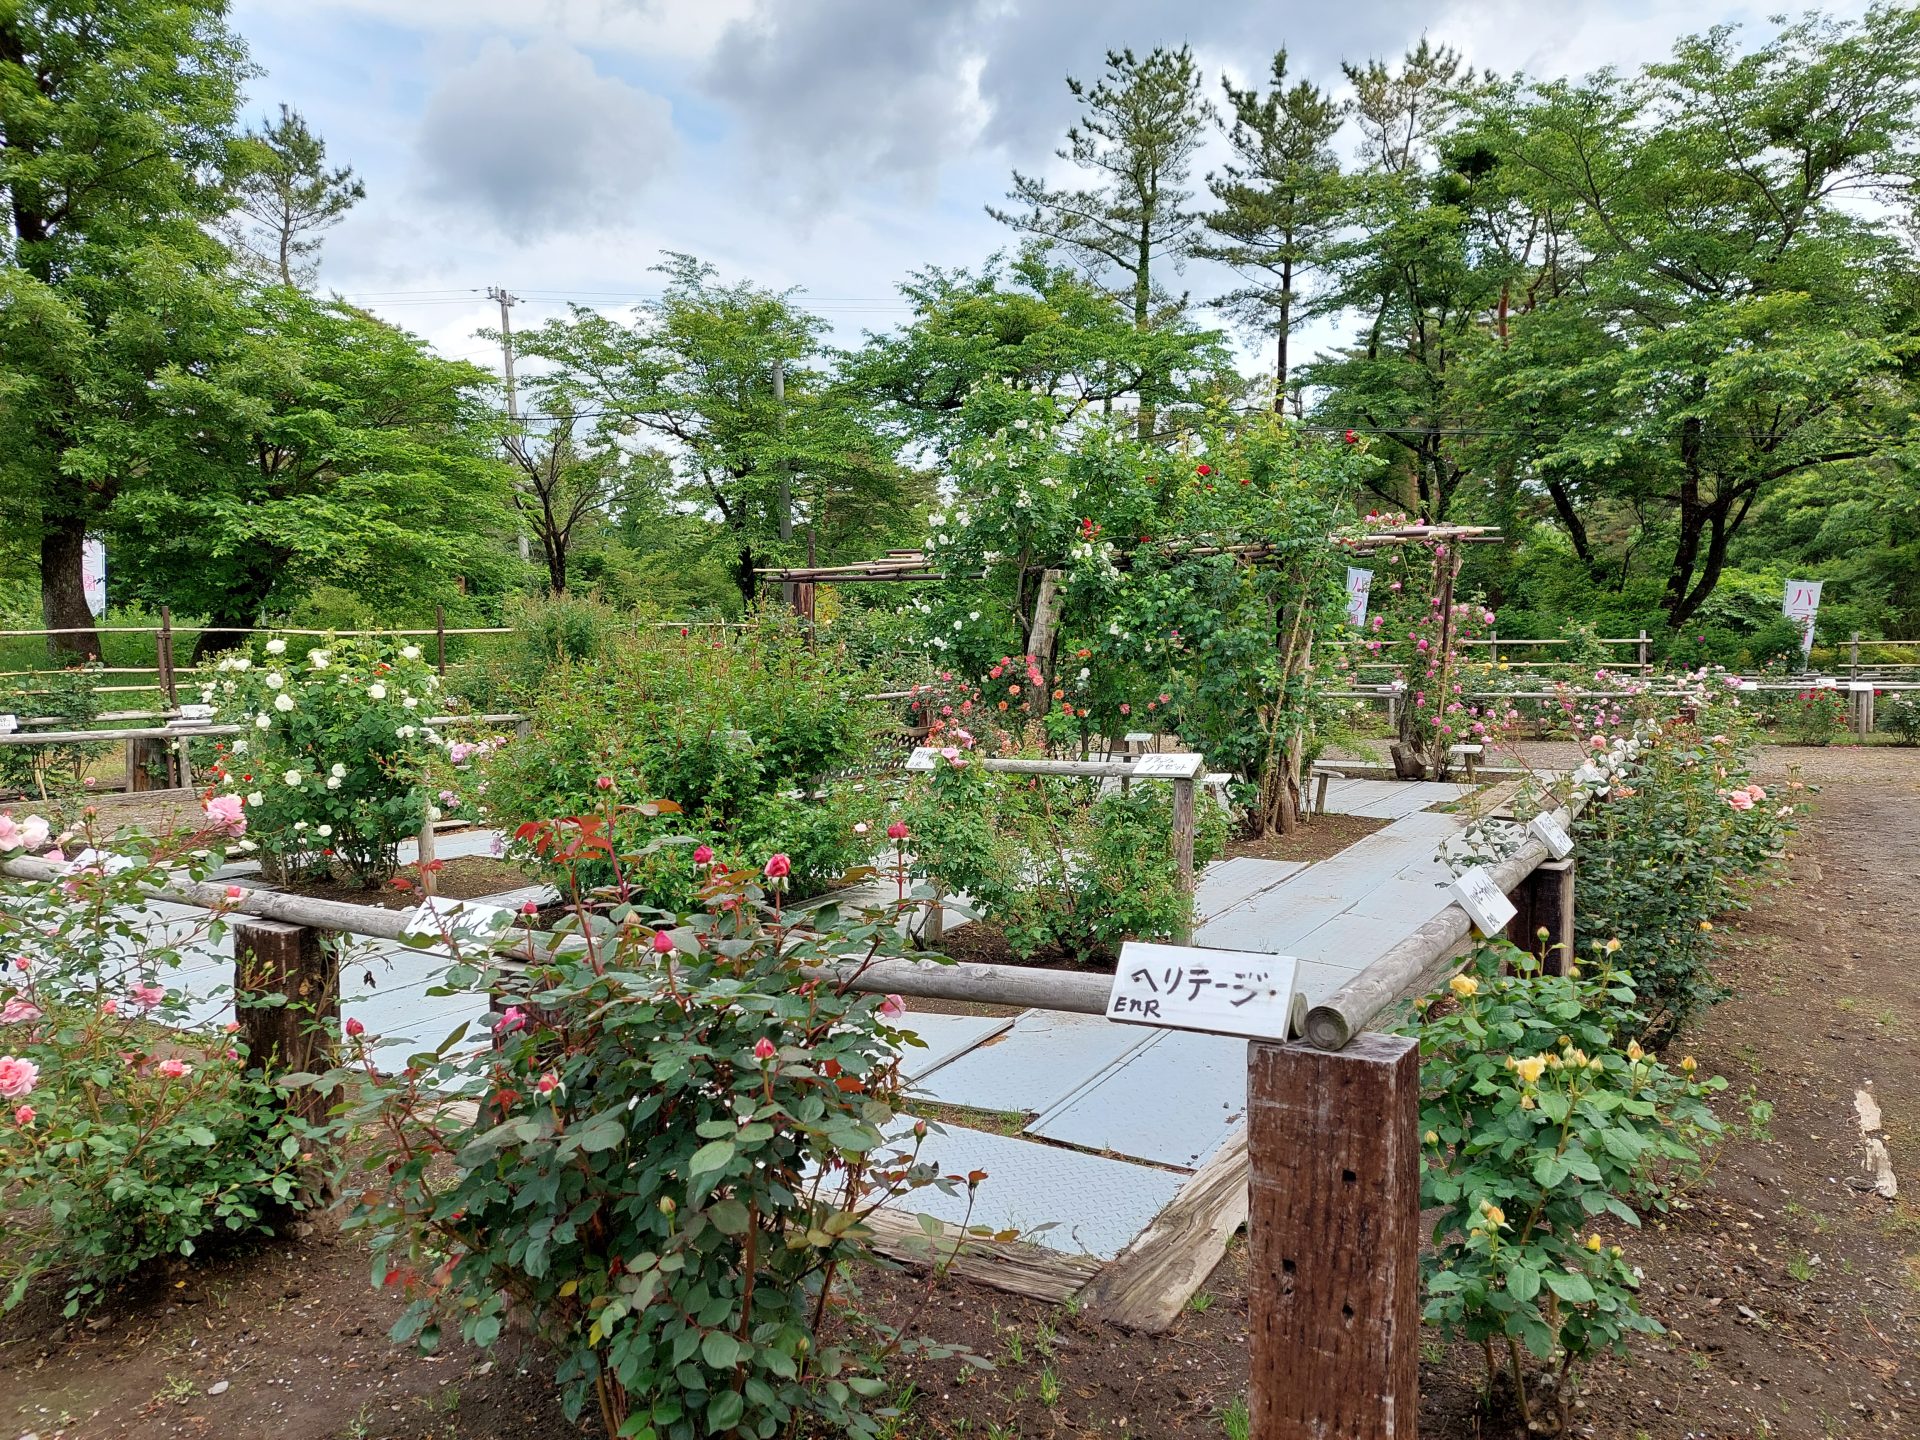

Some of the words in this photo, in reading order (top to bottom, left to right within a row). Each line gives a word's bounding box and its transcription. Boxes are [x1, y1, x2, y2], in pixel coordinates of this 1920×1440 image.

[1131, 966, 1269, 1007] ヘリテージ
